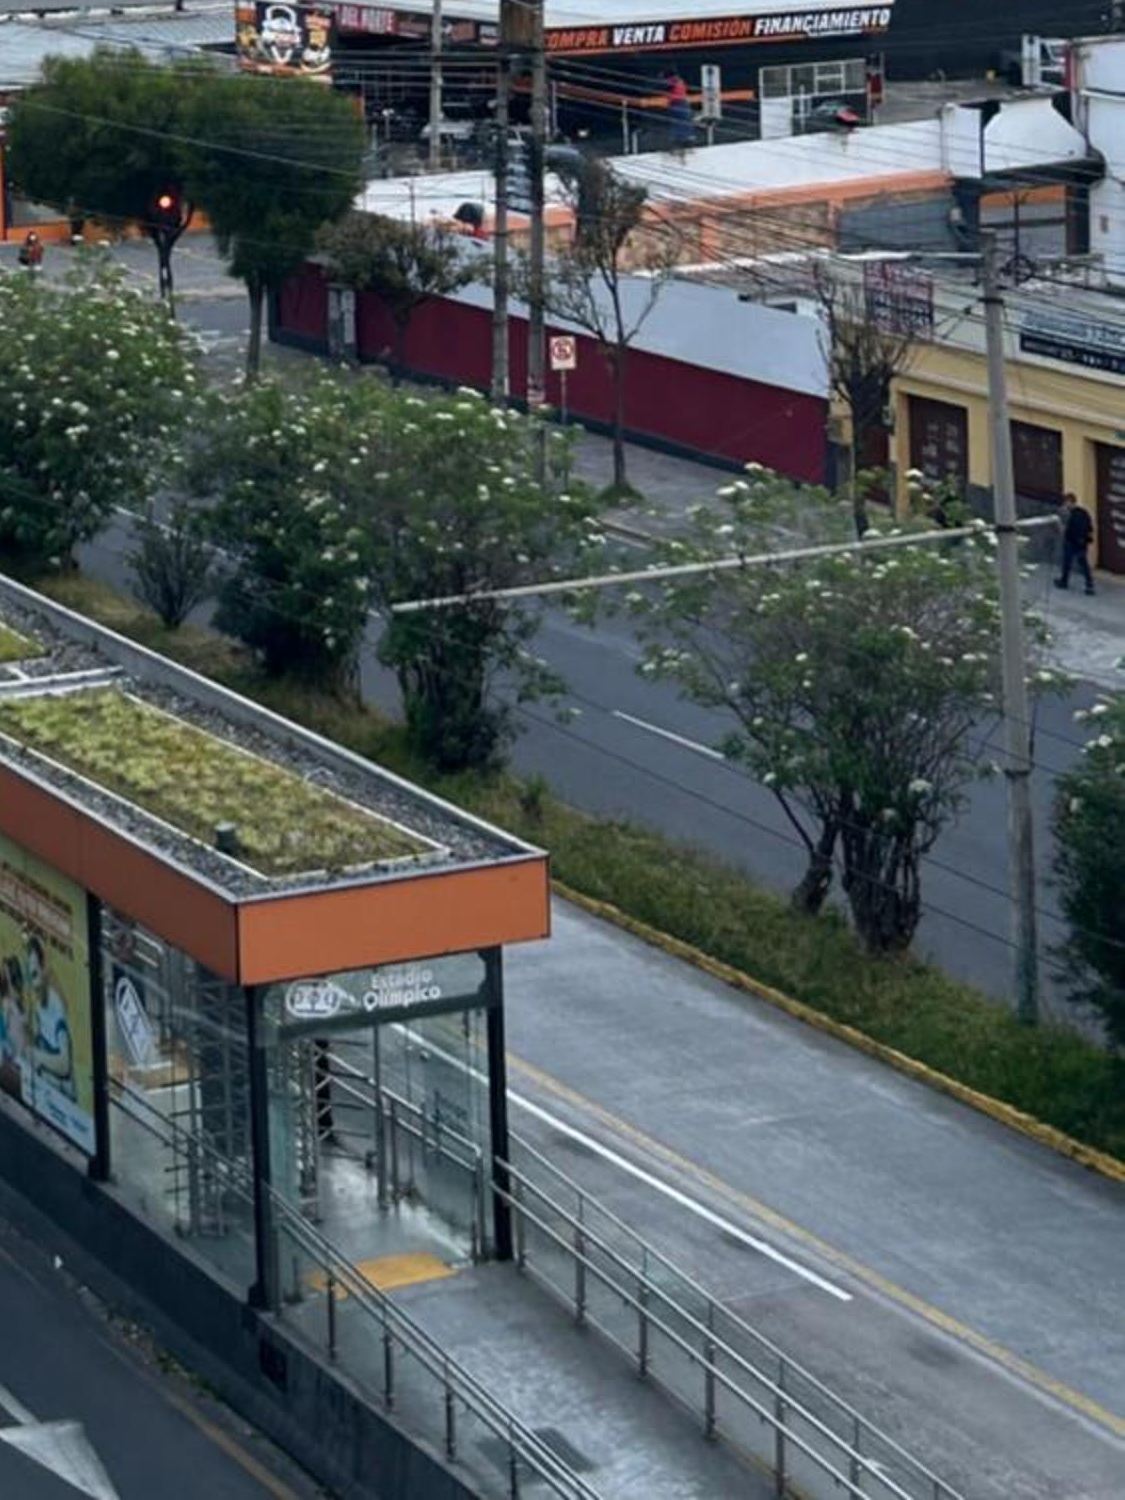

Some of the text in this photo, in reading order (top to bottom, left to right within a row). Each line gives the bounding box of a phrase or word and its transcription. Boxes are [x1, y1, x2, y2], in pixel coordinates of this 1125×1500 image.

[613, 25, 664, 45] VENTA
[668, 17, 752, 42] COMISIÓN
[755, 8, 892, 37] FINANCIAMIENTO
[372, 969, 433, 989] Estadio
